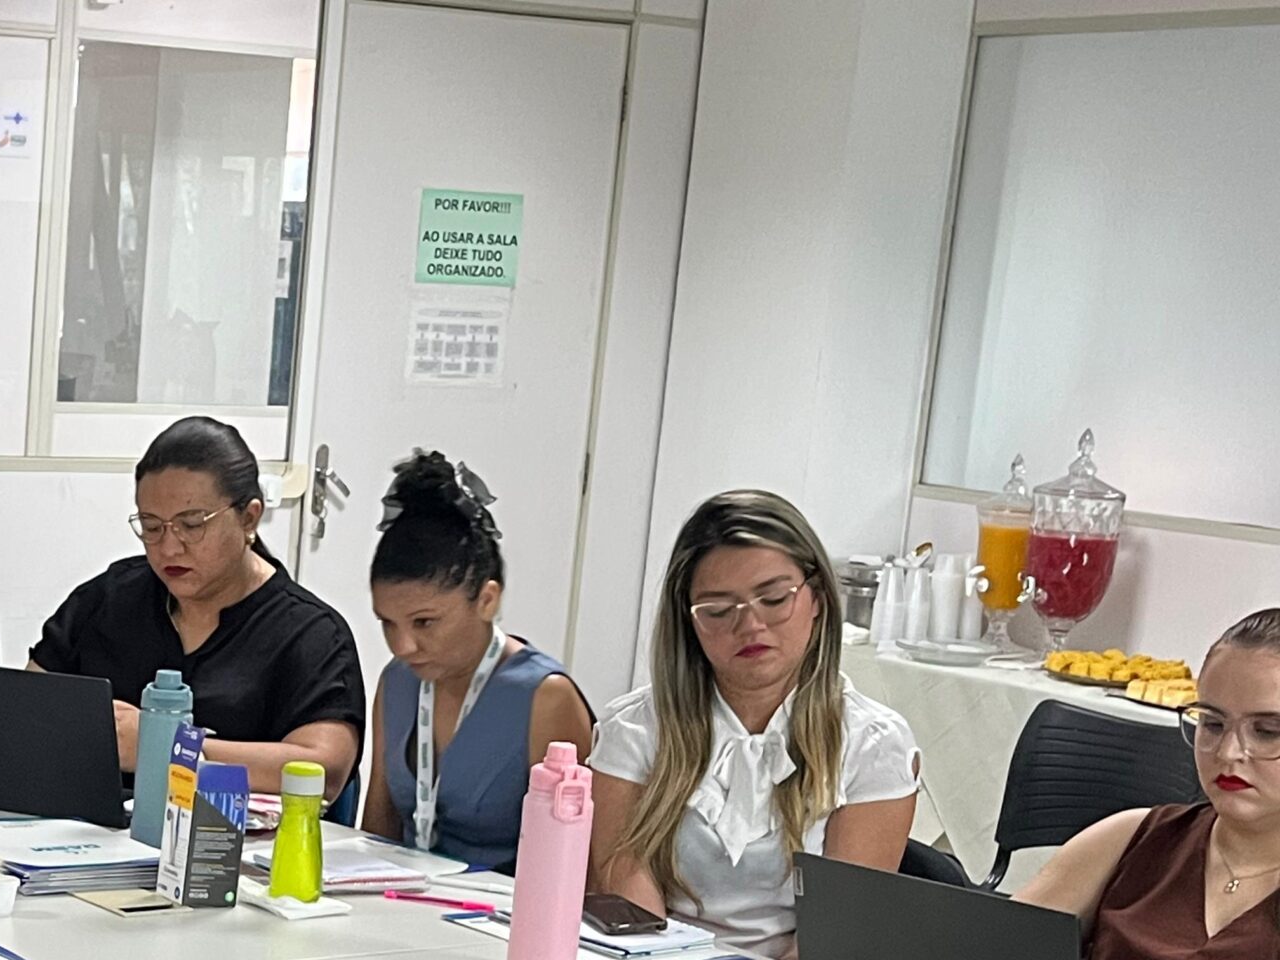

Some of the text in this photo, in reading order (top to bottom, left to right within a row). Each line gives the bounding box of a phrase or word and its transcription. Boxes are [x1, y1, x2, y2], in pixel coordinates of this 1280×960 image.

[434, 198, 512, 215] POR FAVOR!!!
[422, 230, 518, 247] AO USAR A SALA
[434, 247, 503, 262] DEIXE TUDO
[426, 263, 506, 279] ORGANIZADO.
